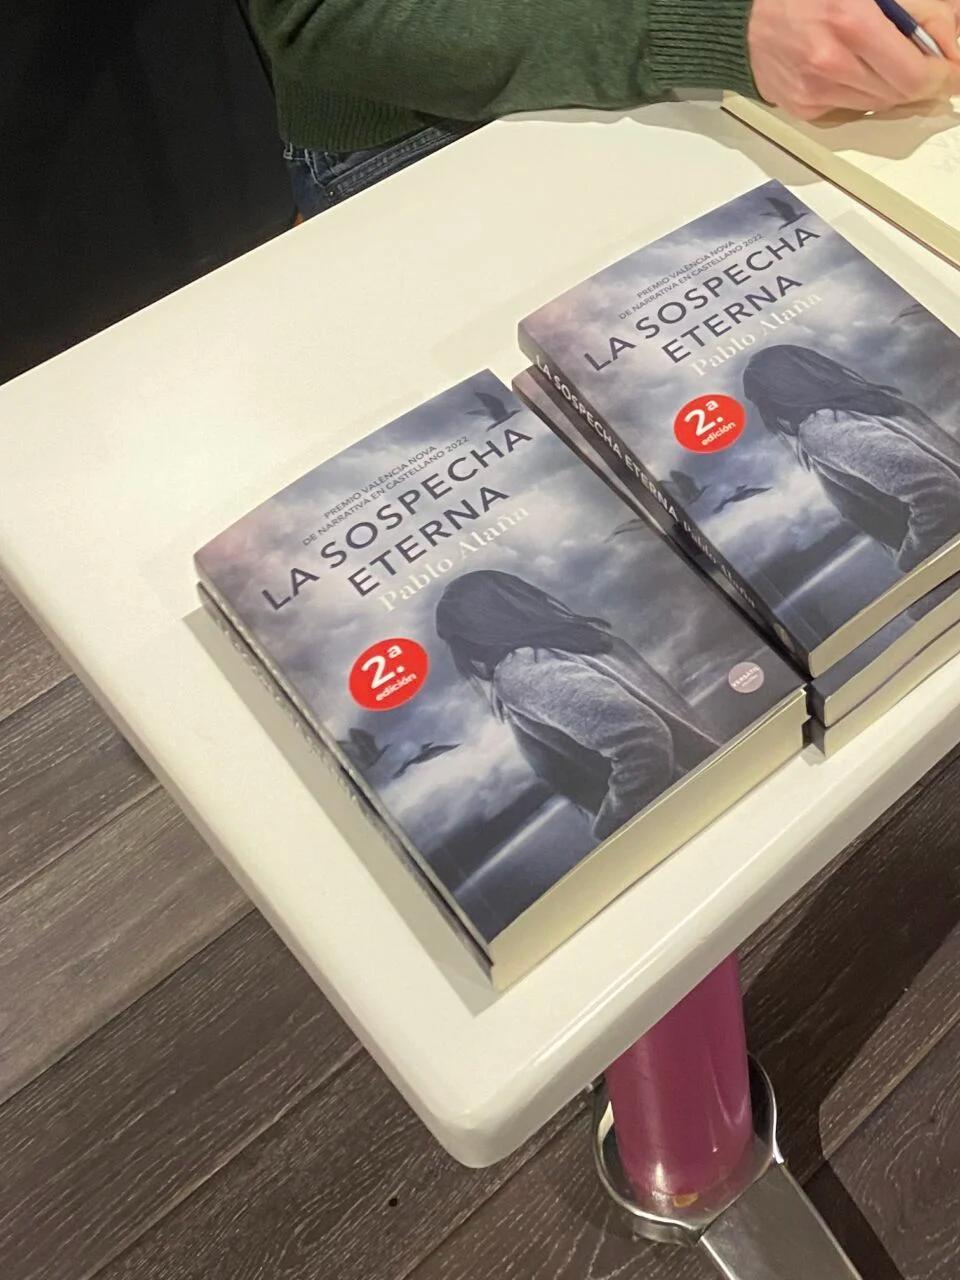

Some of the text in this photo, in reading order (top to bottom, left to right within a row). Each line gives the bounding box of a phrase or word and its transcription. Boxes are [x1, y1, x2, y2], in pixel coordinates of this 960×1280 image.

[584, 226, 821, 372] LA SOSPECHA
[618, 232, 764, 321] DE NARRATIVA EN CASTELLANO 2022
[636, 239, 735, 298] PREMIO VALÈNCIA NOVA
[661, 275, 803, 363] ETERNA
[691, 332, 756, 376] Pablo
[536, 355, 678, 521] LA SOSPECHA ETERNA
[700, 421, 737, 446] edición
[261, 428, 533, 611] LA SOSPECHA
[302, 435, 470, 547] DE NARRATIVA EN CASTELLANO 2022
[323, 445, 438, 519] PREMIO VALÈNCIA NOVA
[347, 486, 511, 597] ETERNA
[377, 506, 530, 613] Pablo Alaña
[373, 671, 418, 702] edición
